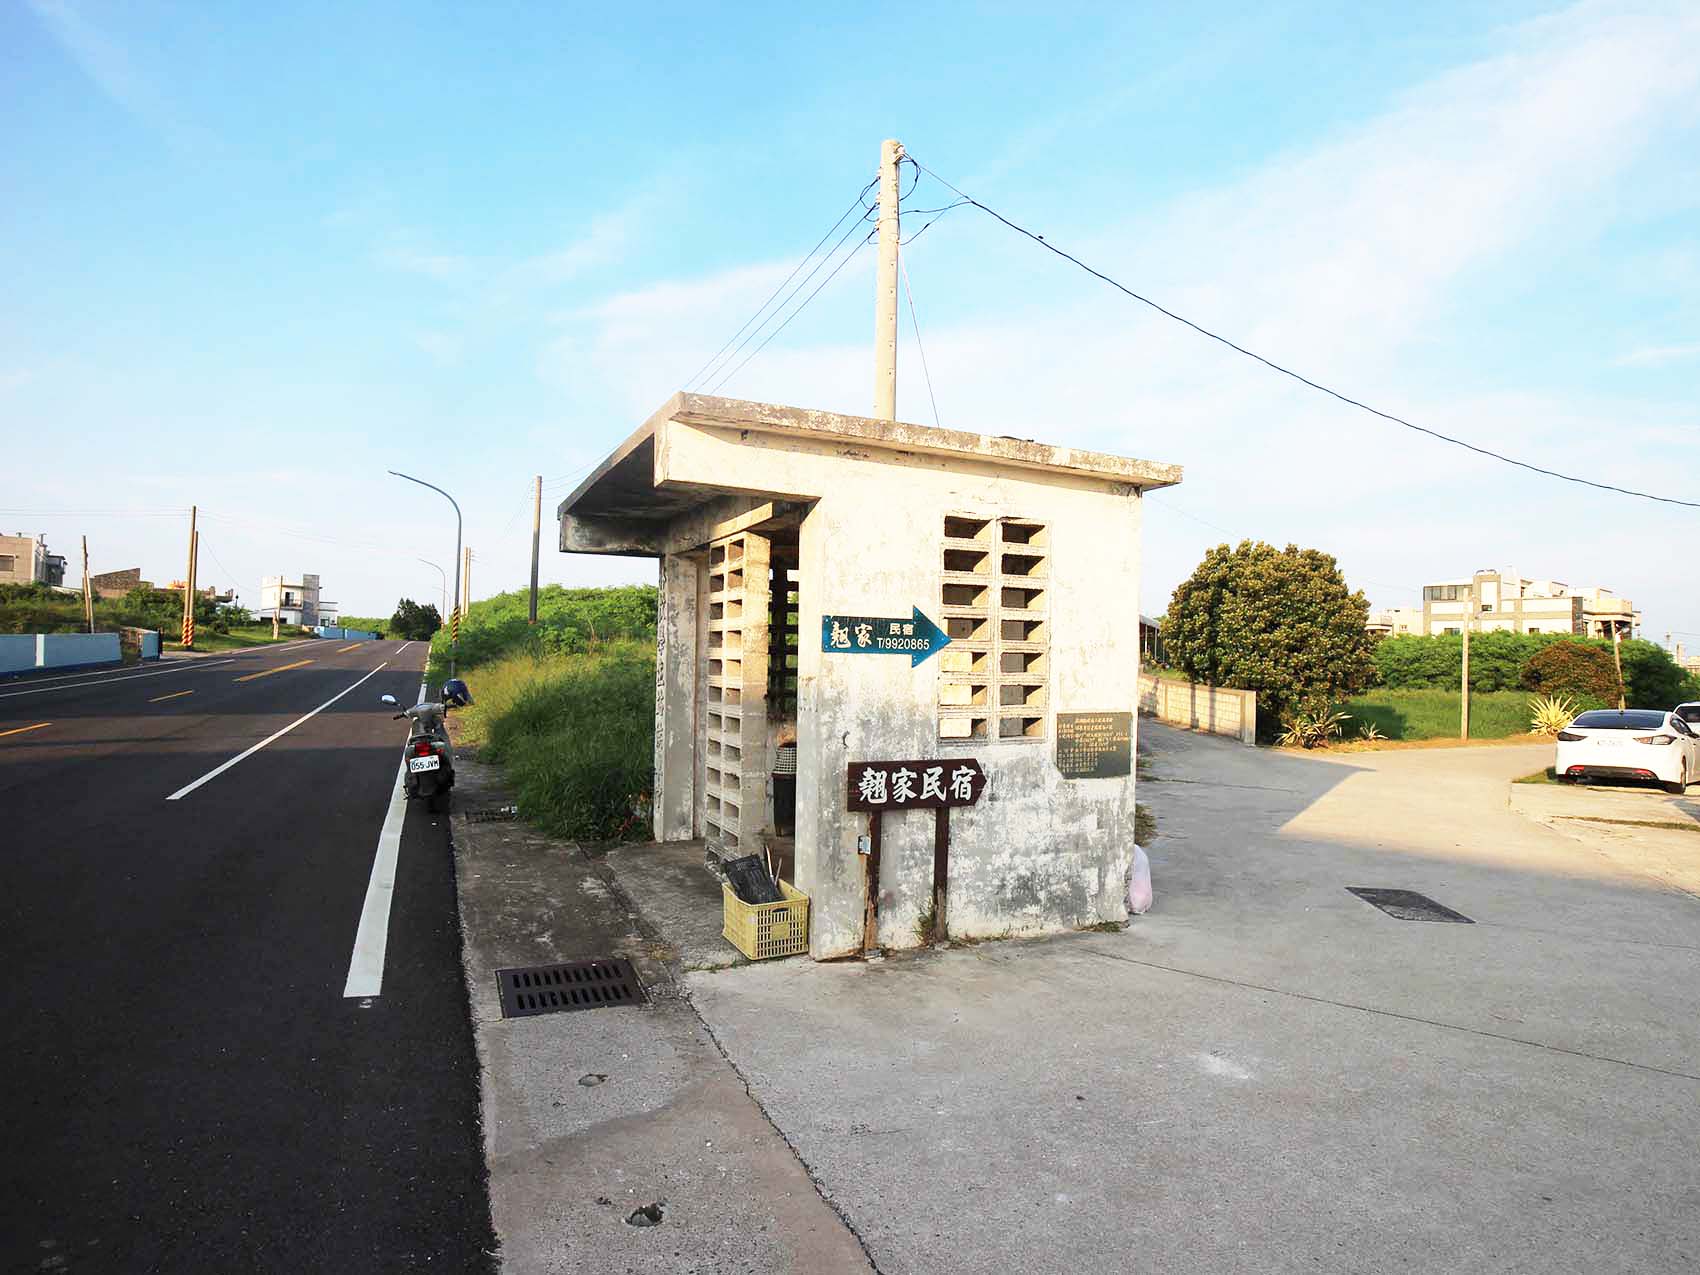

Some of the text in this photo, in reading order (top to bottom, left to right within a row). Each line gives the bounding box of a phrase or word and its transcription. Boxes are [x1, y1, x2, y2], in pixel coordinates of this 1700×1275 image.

[889, 623, 914, 636] 民宿
[877, 637, 930, 650] T/9920865
[858, 765, 977, 803] 翹家民宿
